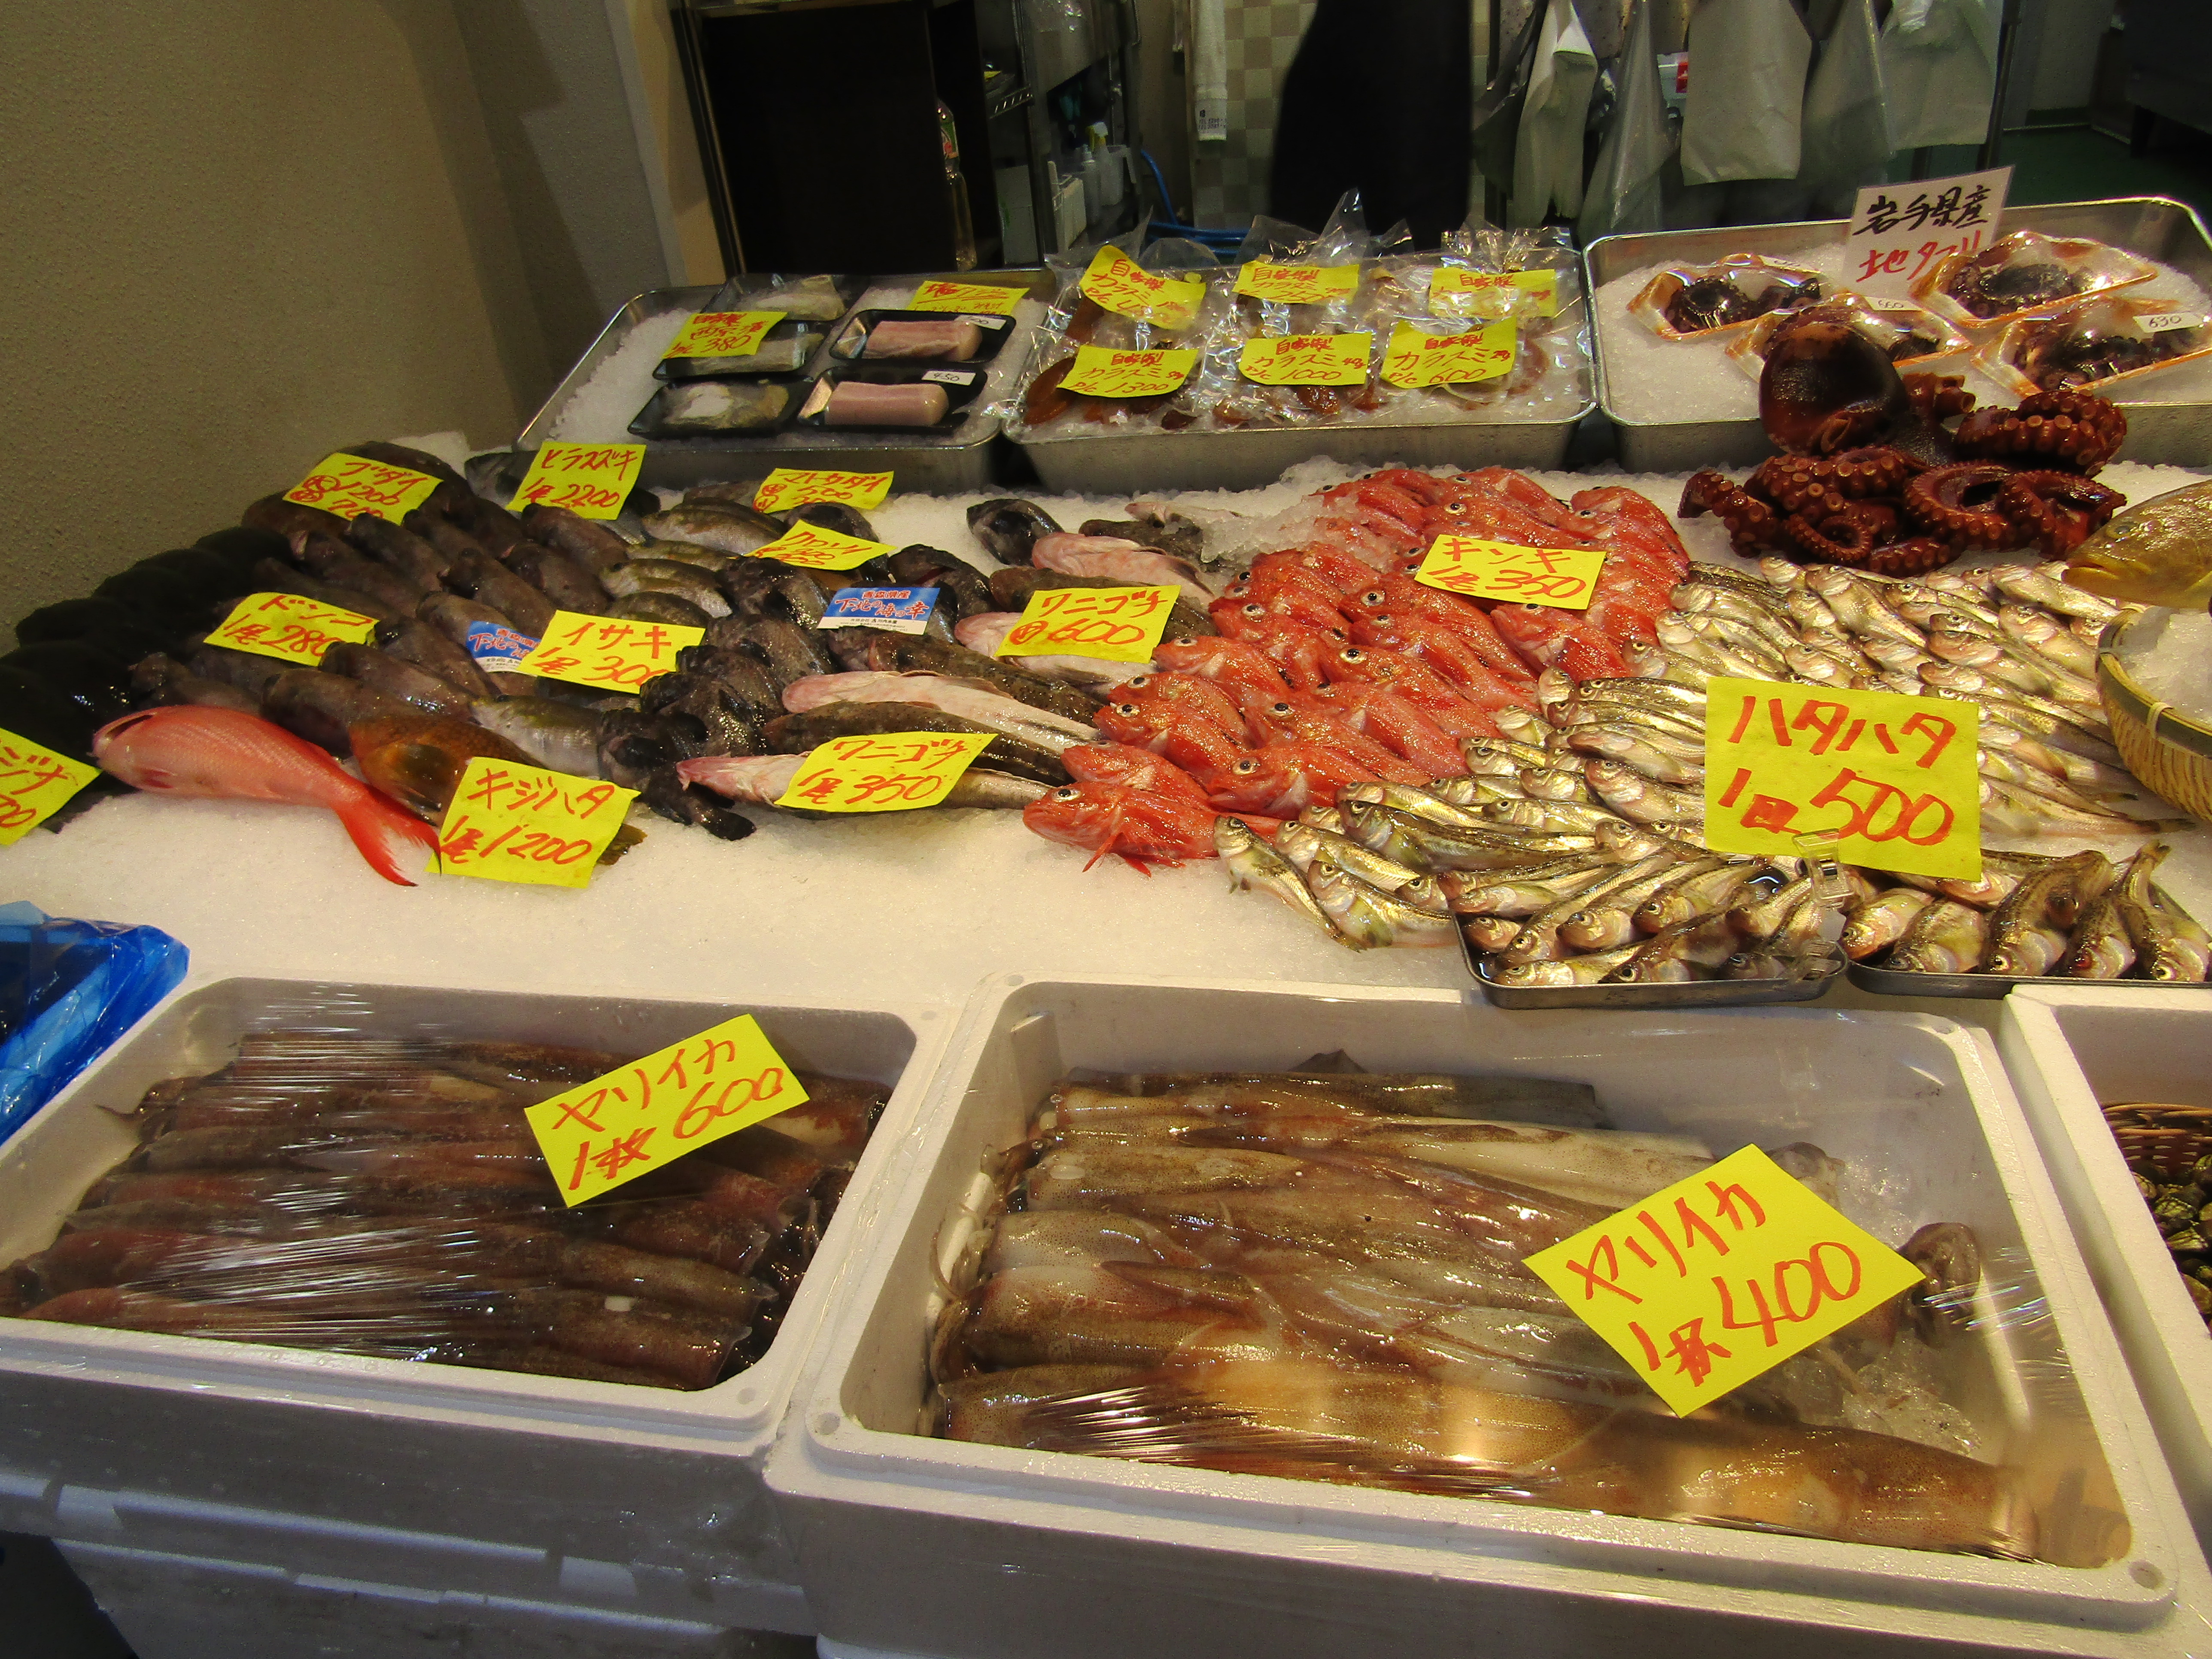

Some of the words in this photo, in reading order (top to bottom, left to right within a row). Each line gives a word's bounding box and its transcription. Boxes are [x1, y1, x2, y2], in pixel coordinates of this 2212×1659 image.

[1852, 185, 1991, 236] 岩手県産
[1253, 281, 1317, 291] カラスミ
[701, 335, 751, 352] 380
[1079, 368, 1161, 380] カラスミ
[1252, 354, 1337, 368] カラスミ
[1280, 369, 1342, 380] 1000
[1394, 348, 1490, 371] カラスミ
[1105, 382, 1169, 393] 1300
[1429, 368, 1486, 383] 600
[340, 462, 428, 497] ブダイ
[541, 448, 637, 481] ヒラスズキ
[550, 484, 620, 508] 2200
[777, 472, 888, 492] マトウダイ
[781, 531, 872, 554] クロソイ
[1442, 538, 1570, 573] キンキ
[1486, 569, 1586, 598] 350
[258, 595, 373, 626] ドンコ
[835, 598, 930, 619] 下北の海の幸
[1039, 590, 1168, 618] ワニゴチ
[562, 622, 672, 659] イサキ
[1048, 618, 1145, 644] 600
[582, 656, 669, 687] 30
[1728, 696, 1957, 768] ハタハタ
[833, 739, 968, 770] ワニゴチ
[467, 768, 615, 820] キジハタ
[845, 774, 942, 805] 350
[1810, 768, 1954, 845] 500
[479, 824, 592, 865] 1200
[552, 1039, 735, 1132] ヤリイカ
[673, 1068, 784, 1139] 600
[1566, 1181, 1765, 1304] ヤリイカ
[1711, 1242, 1861, 1347] 400
